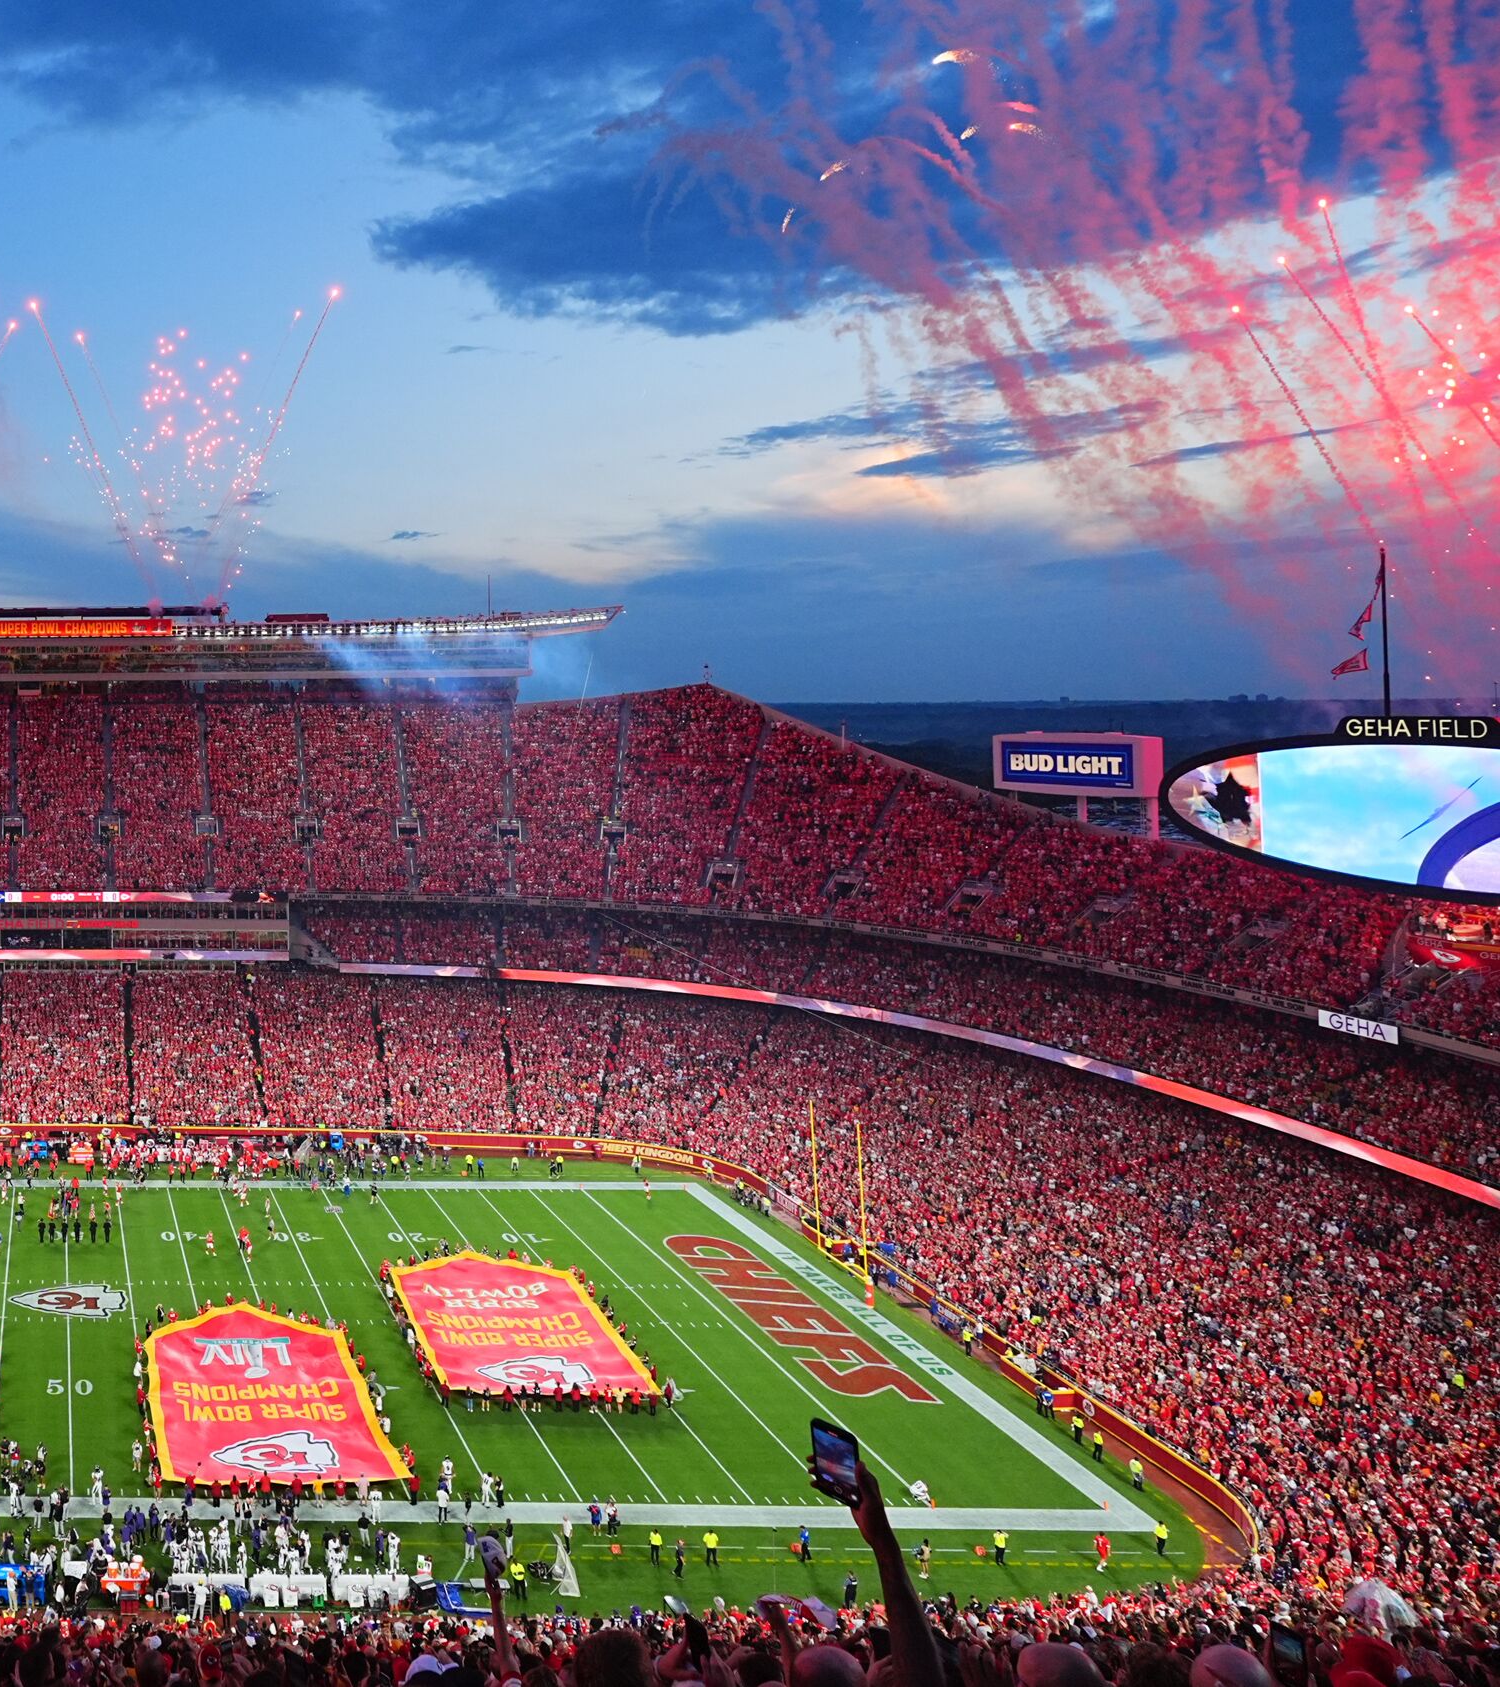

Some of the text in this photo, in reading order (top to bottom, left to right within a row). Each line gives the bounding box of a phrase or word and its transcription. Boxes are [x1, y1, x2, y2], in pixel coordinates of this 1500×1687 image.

[32, 622, 61, 635] BOWL
[64, 622, 128, 635] CHAMPIONS
[1346, 718, 1488, 739] GEHA FIELD
[1010, 754, 1054, 772] BUD
[50, 892, 75, 901] 0:00
[28, 919, 65, 929] FIELD
[1416, 937, 1444, 948] GEHA
[1134, 968, 1166, 982] THOMAS
[1181, 979, 1236, 996] HANK STRAM
[1272, 998, 1306, 1013] WILSON
[1328, 1014, 1386, 1040] GEHA
[635, 1146, 694, 1164] KINGDOM
[460, 1281, 550, 1298] BOWL
[444, 1299, 540, 1310] SUPER
[425, 1309, 582, 1331] CHAMPIONS
[663, 1234, 944, 1405] CHIEFS
[776, 1251, 954, 1377] IT TAKES ALL OF US
[432, 1328, 596, 1348] SUPER BOWL
[200, 1343, 292, 1366] LIV
[172, 1379, 340, 1402] CHAMPIONS
[176, 1398, 348, 1422] SUPER BOWL
